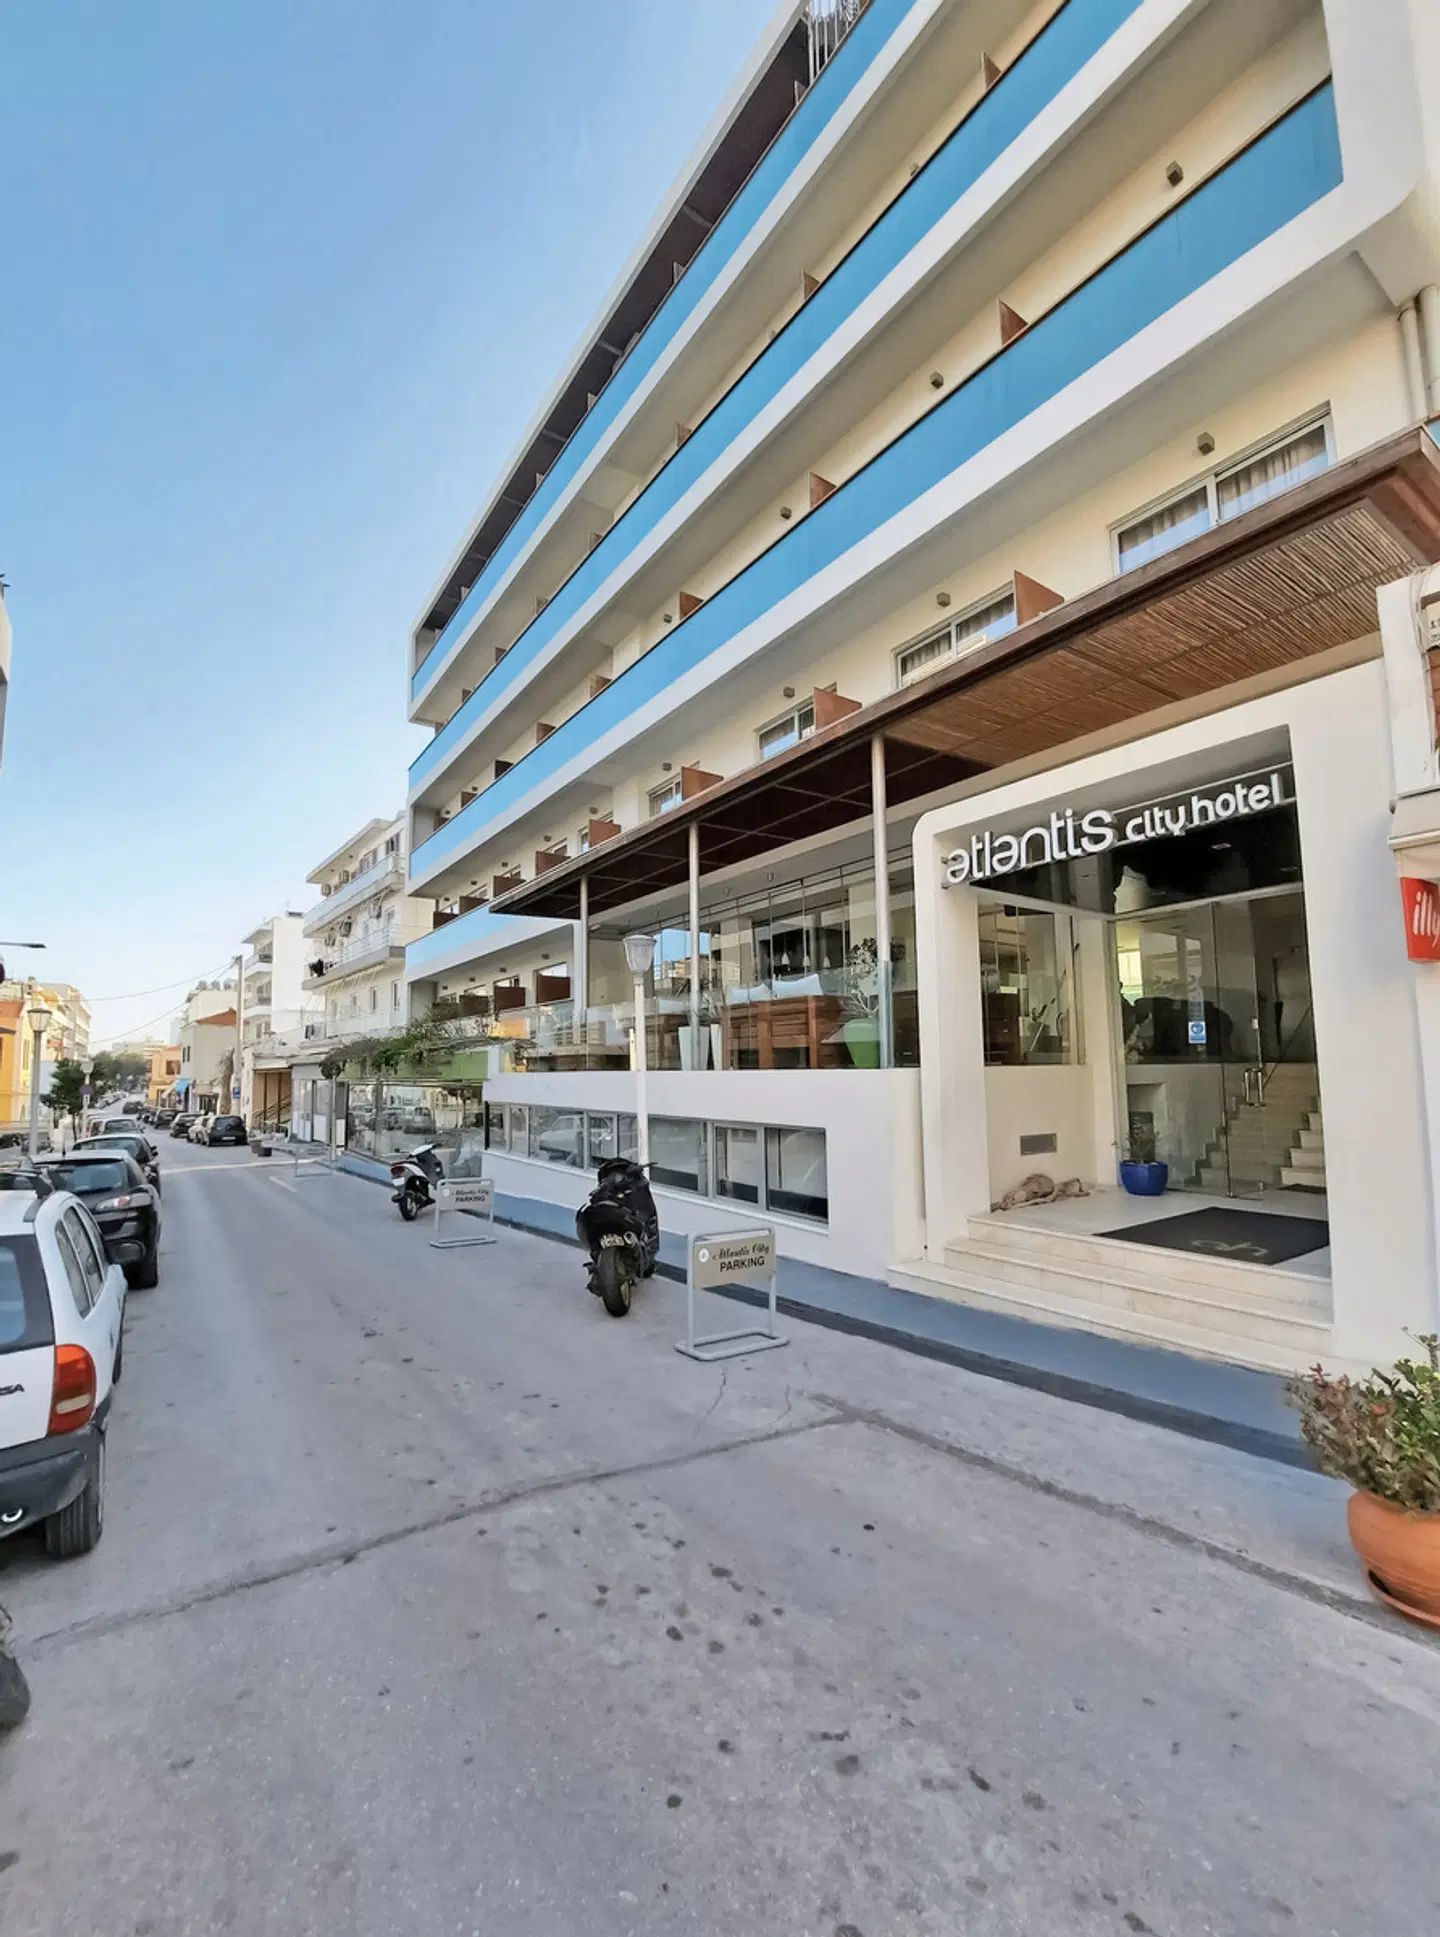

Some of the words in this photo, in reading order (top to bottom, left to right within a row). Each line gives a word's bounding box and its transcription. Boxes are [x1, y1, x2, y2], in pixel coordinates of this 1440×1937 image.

[945, 808, 1119, 885] atlantis
[1191, 772, 1285, 826] hotel
[719, 1256, 765, 1272] PARKING
